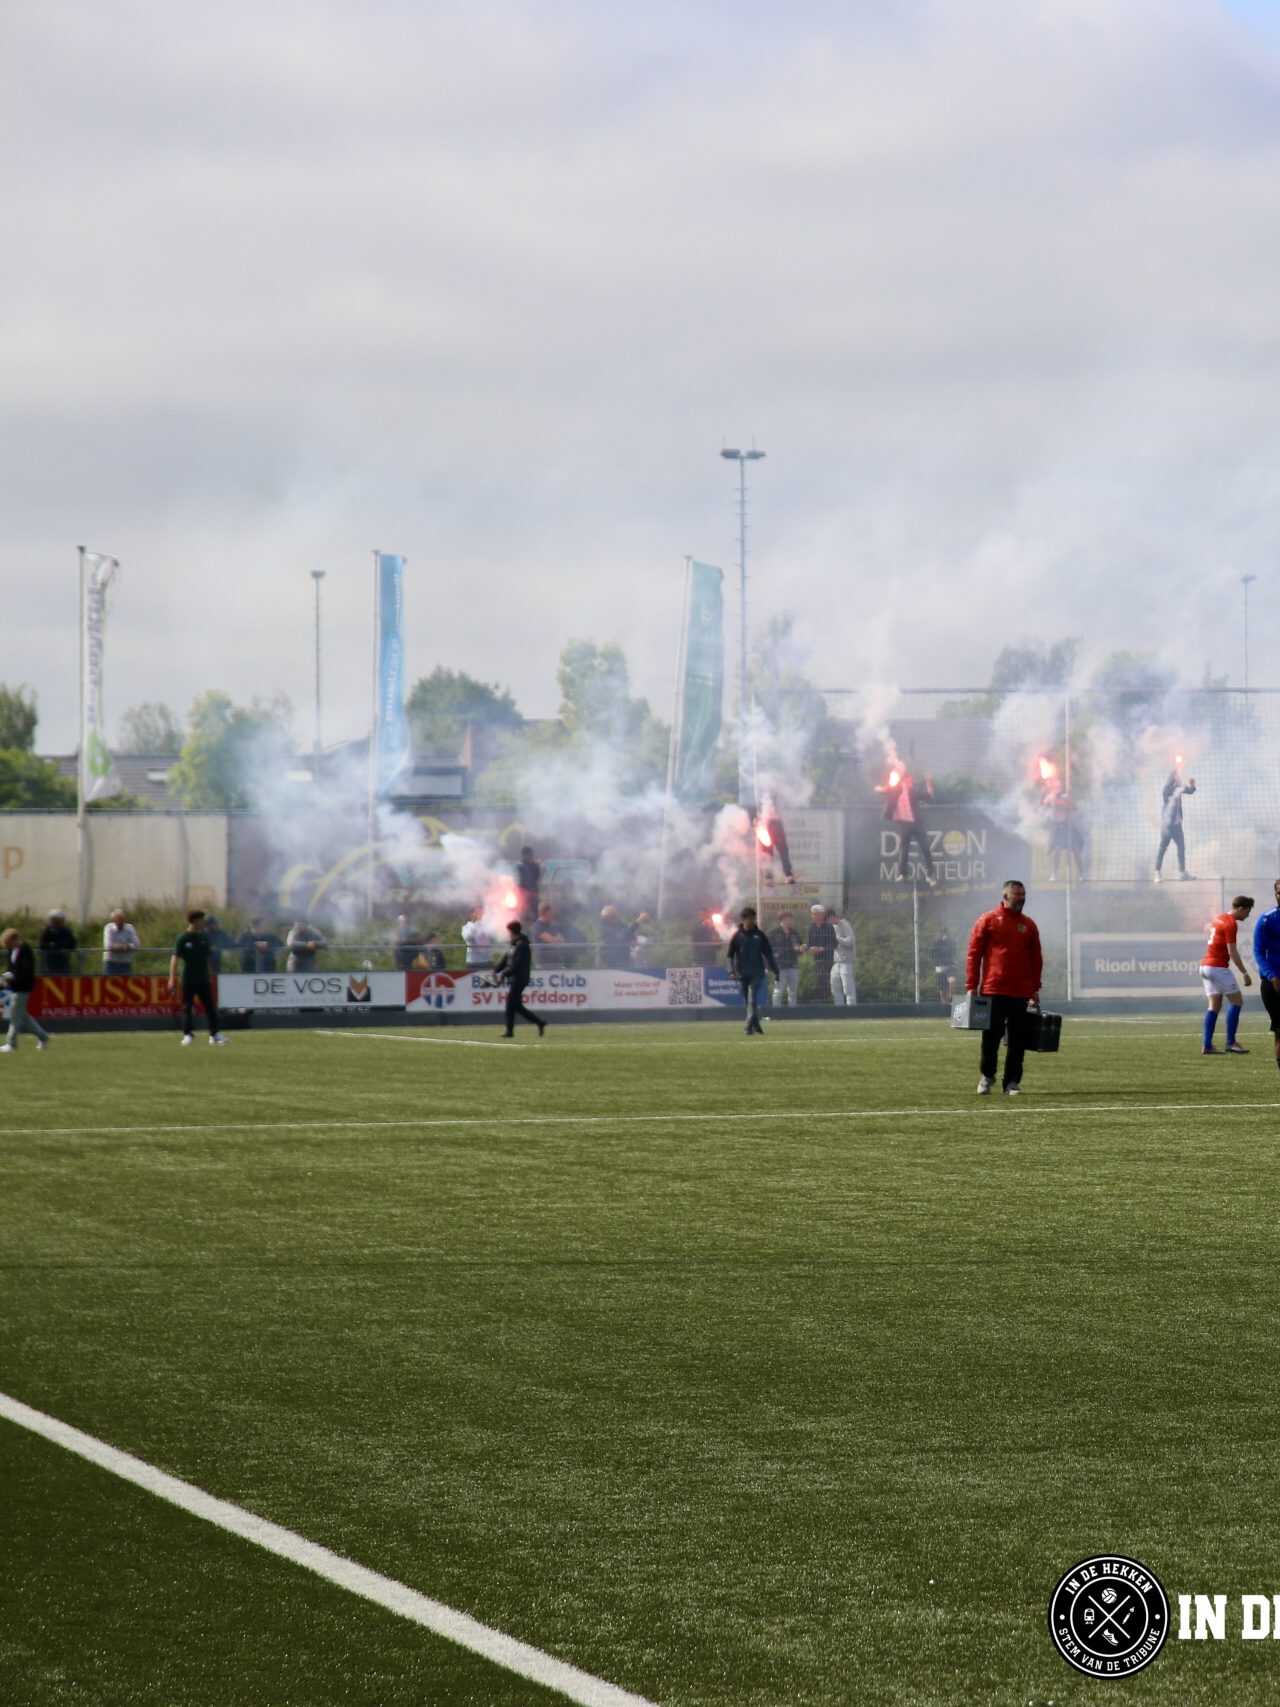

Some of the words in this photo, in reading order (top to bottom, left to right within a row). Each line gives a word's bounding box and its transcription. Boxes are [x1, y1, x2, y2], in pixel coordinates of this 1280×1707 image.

[1095, 955, 1136, 973] Riool
[1138, 958, 1201, 976] verstop
[253, 978, 286, 995] DE
[293, 976, 343, 995] VOS
[548, 973, 587, 988] Club
[472, 991, 494, 1005] SV
[497, 990, 587, 1006] Hofddorp
